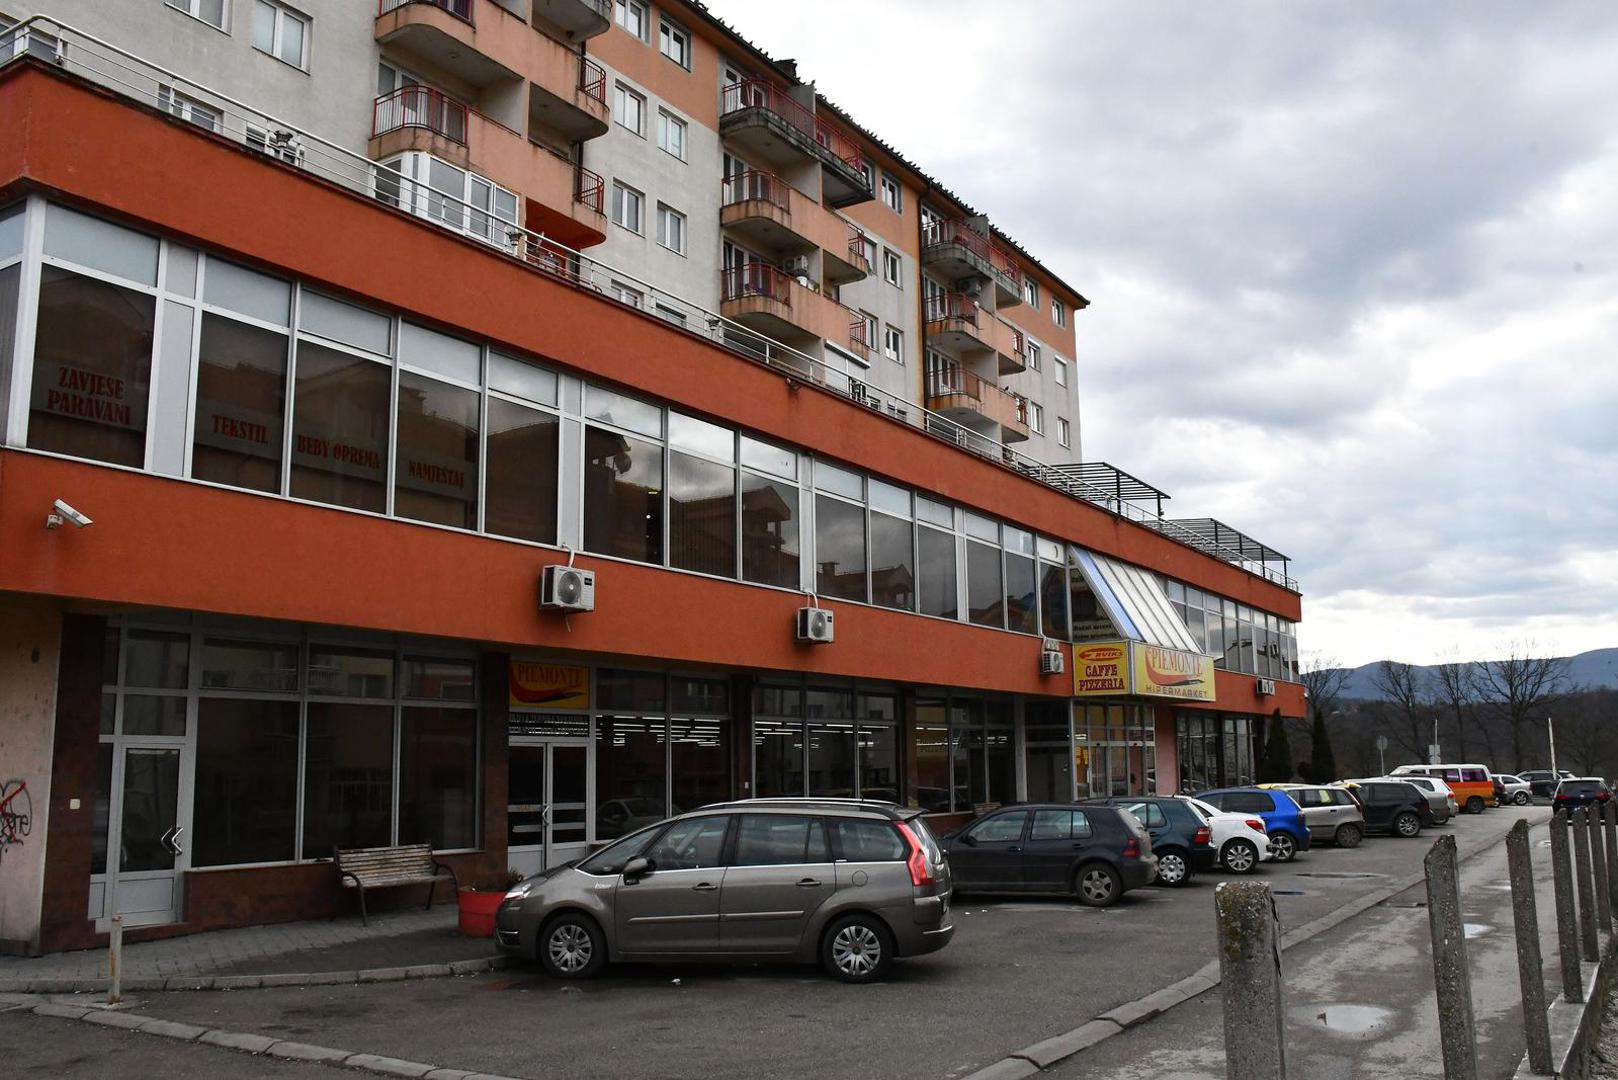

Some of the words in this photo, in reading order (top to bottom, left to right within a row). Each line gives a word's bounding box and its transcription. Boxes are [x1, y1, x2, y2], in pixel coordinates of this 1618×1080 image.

[58, 366, 125, 400] ZAVJESE
[47, 387, 131, 425] PARAVANI
[211, 414, 268, 444] TEKSTIL
[297, 435, 331, 458] BEBY
[333, 443, 381, 470] OPREMA
[1085, 664, 1117, 677] CAFFE
[1151, 650, 1203, 676] PIEMONTE
[1079, 677, 1125, 691] PIZZERIA
[1145, 684, 1208, 697] HIPERMARKET
